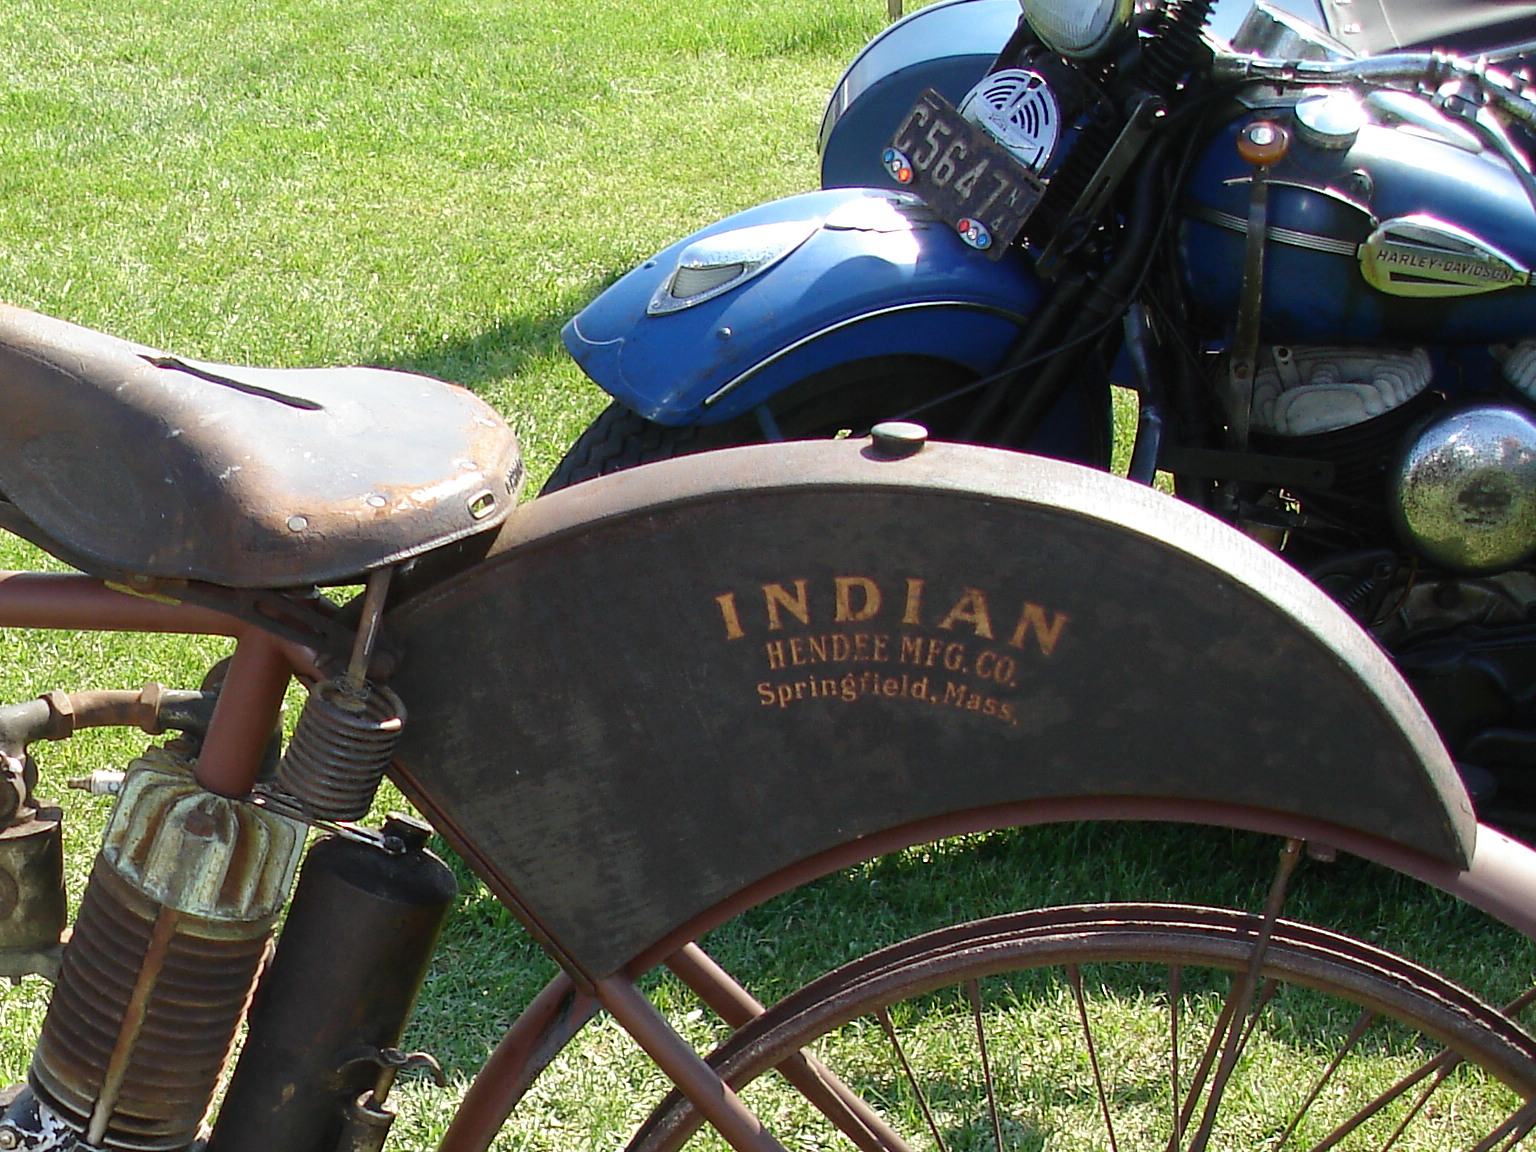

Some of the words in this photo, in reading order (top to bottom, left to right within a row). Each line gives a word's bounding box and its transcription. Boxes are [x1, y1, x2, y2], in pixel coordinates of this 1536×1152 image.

[893, 105, 1010, 219] C5647
[1376, 249, 1512, 281] HARLEY-DAVIDSON
[715, 576, 1069, 656] INDIAN
[766, 633, 889, 669] HENDEE
[900, 635, 970, 673] MFG.
[976, 650, 1018, 687] CO.
[757, 672, 938, 708] Springfield,
[945, 682, 1019, 724] Mass.
